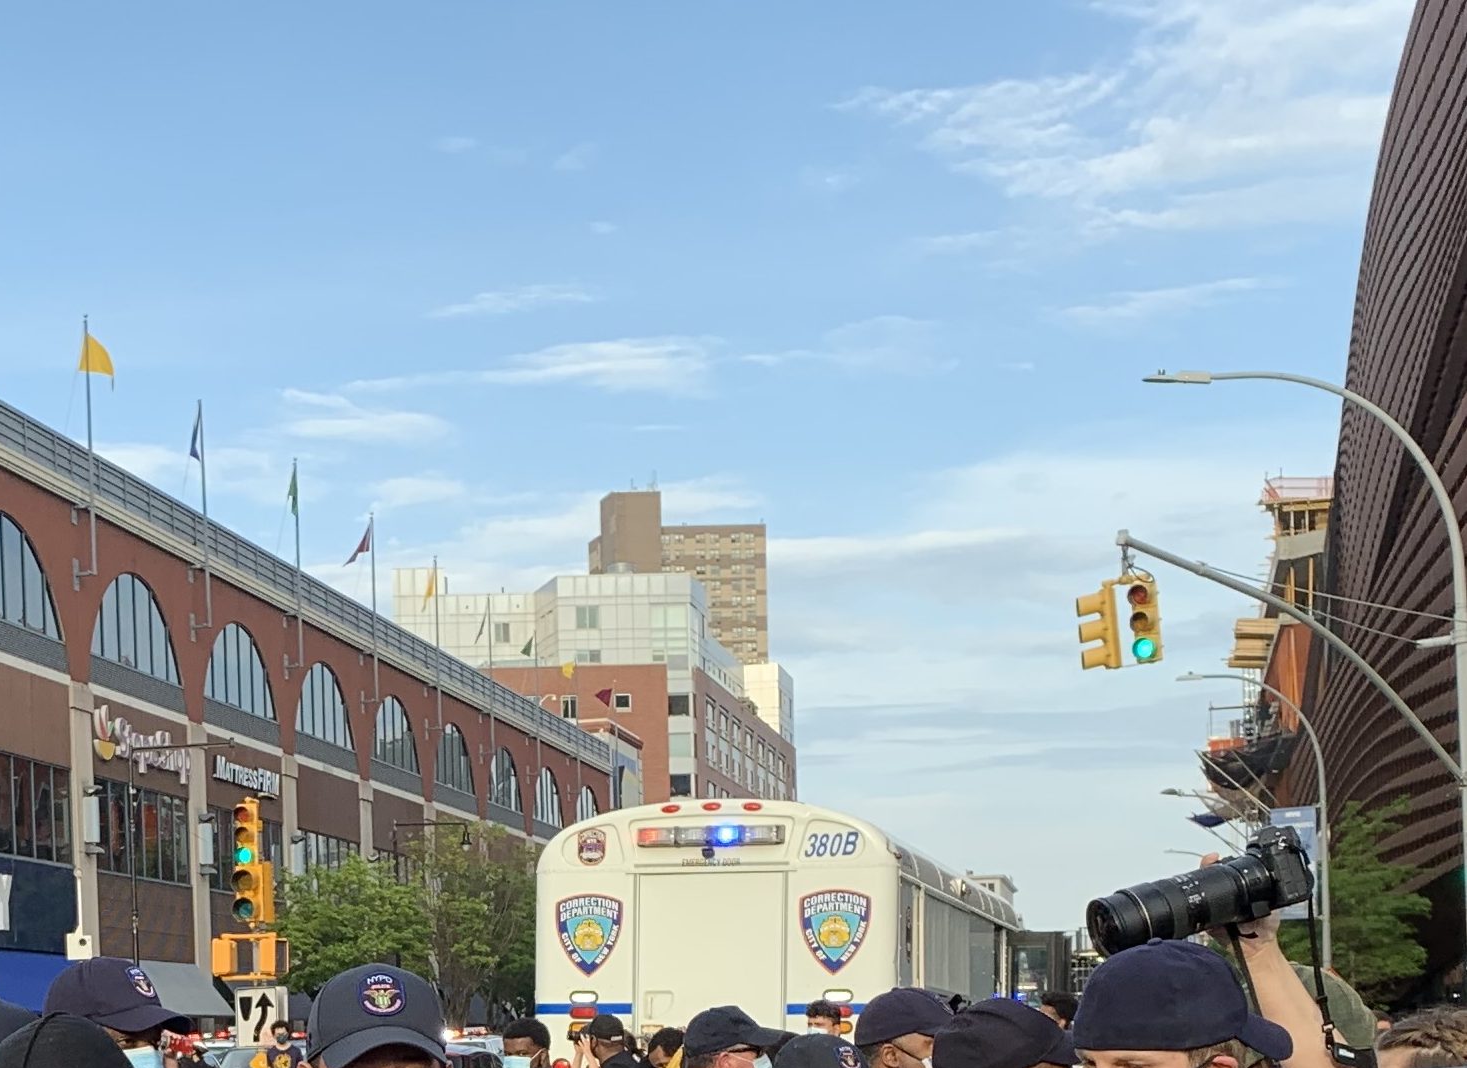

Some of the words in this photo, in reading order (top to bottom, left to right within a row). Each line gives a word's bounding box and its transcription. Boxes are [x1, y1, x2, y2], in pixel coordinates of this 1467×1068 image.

[804, 831, 859, 858] 380B
[559, 896, 619, 912] CORRECTION
[803, 892, 868, 908] CORRECTION
[803, 901, 868, 918] DEPARTMENT
[560, 906, 619, 922] DEPARTMENT
[560, 932, 573, 953] CITY
[594, 946, 611, 965] NEW
[606, 923, 620, 948] YORK
[805, 927, 818, 949] CITY
[815, 949, 827, 961] OF
[839, 942, 857, 962] NEW
[852, 920, 868, 945] YORK
[367, 974, 393, 985] NYPD
